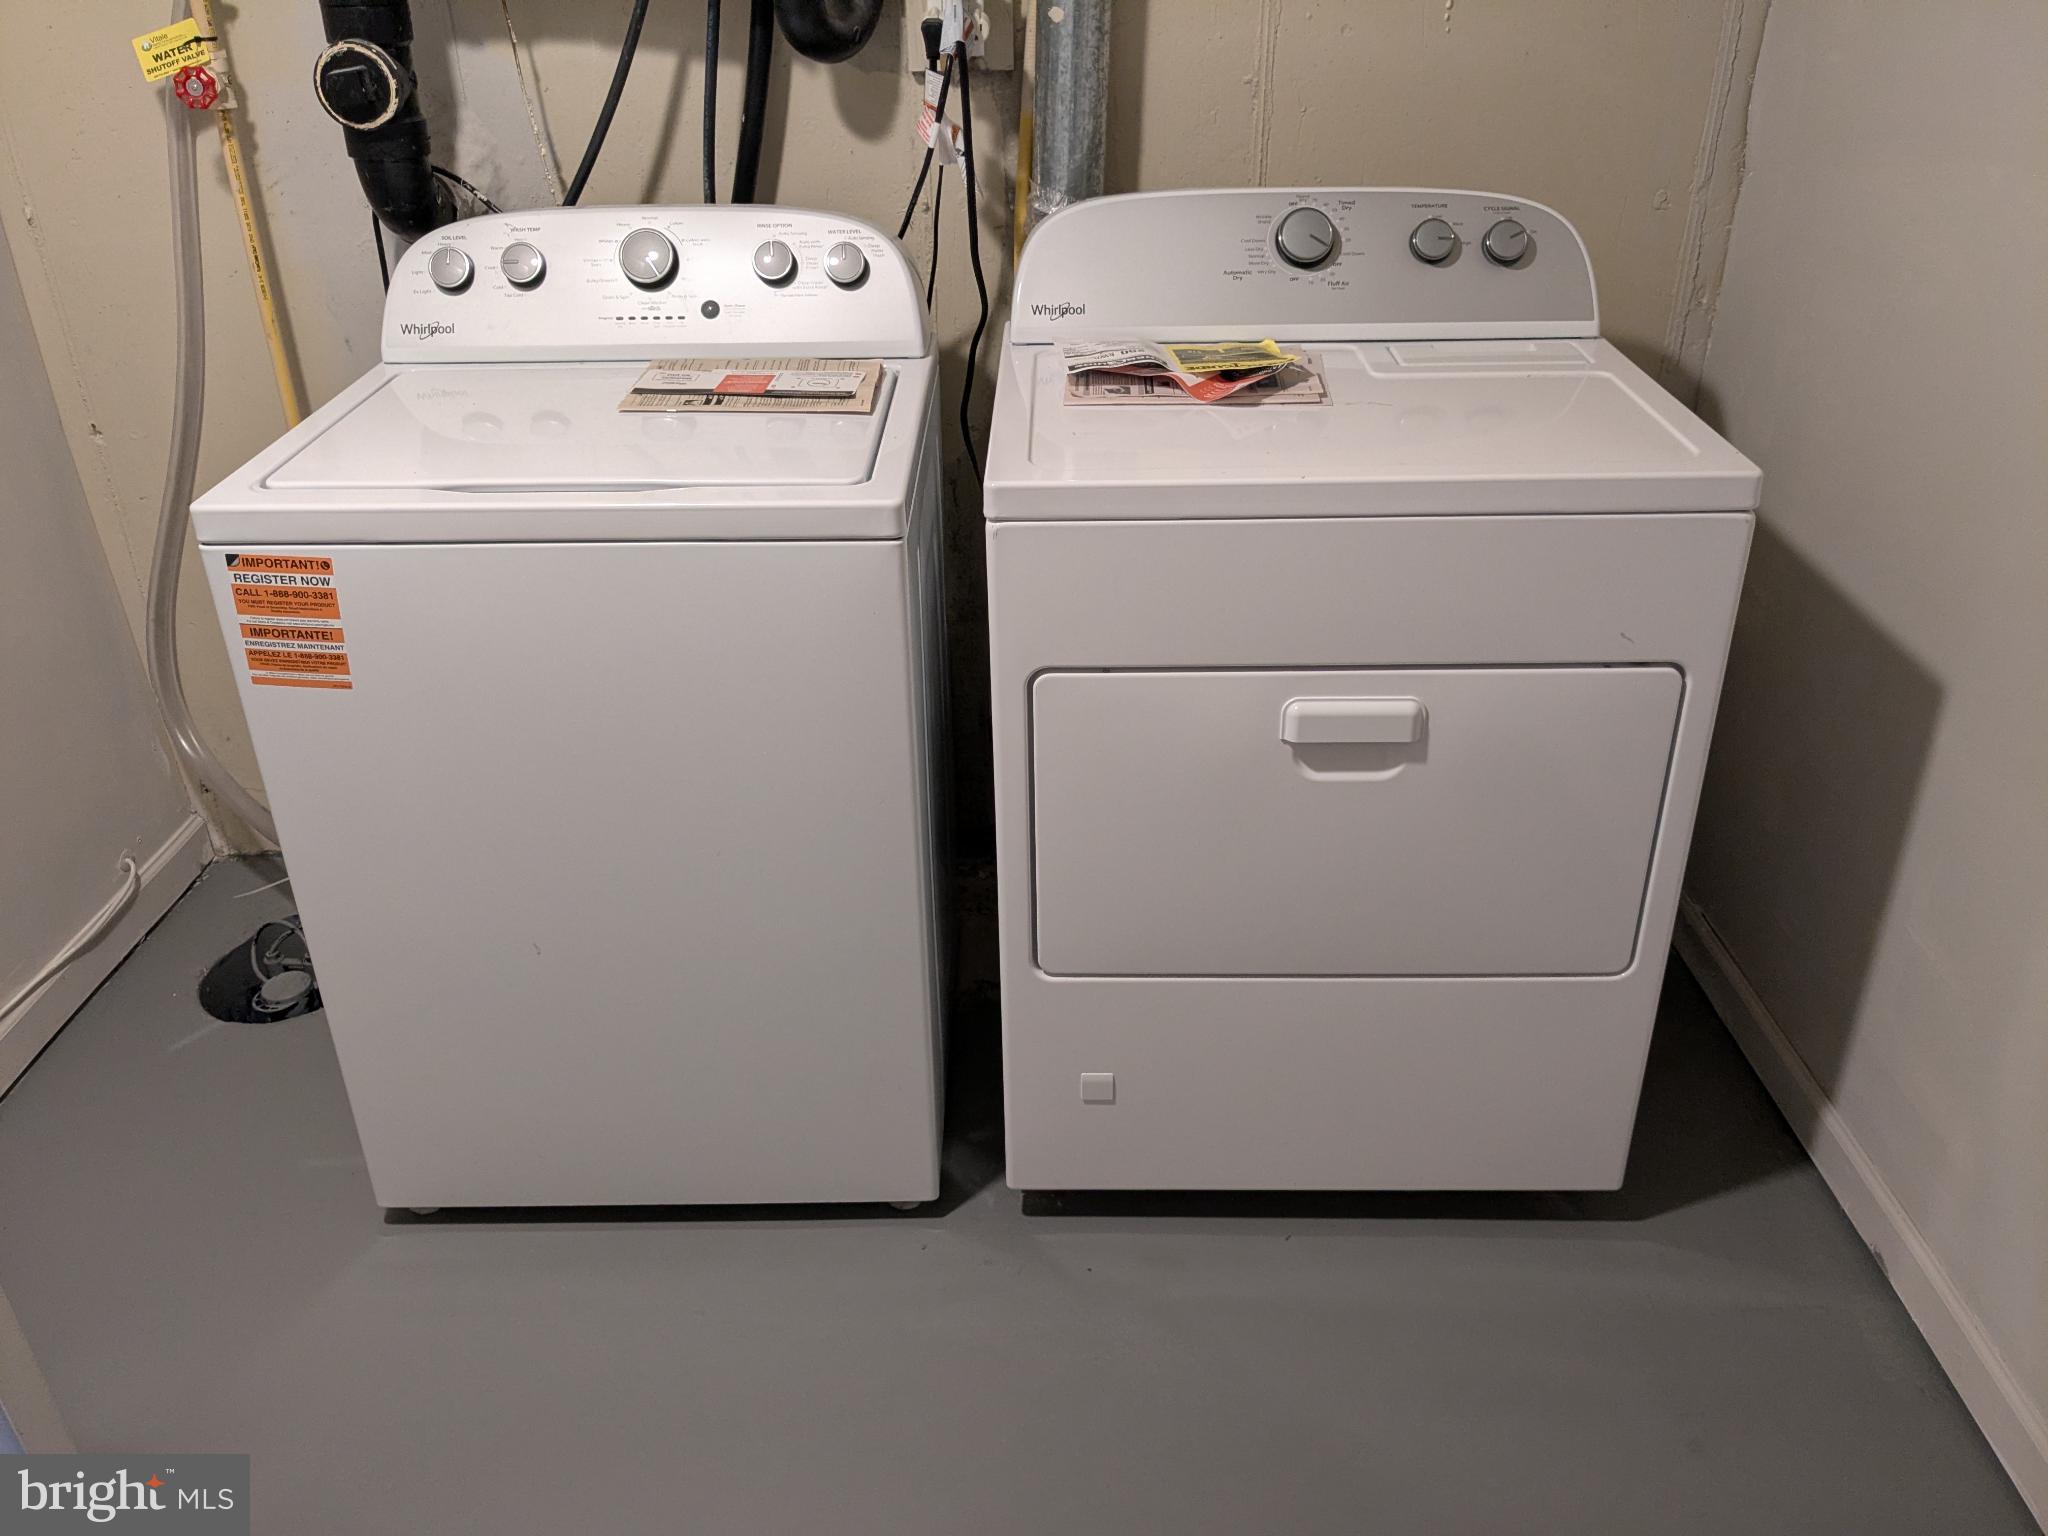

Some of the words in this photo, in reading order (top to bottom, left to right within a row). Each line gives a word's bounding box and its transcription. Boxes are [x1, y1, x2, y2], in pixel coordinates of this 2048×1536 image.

[152, 44, 192, 63] WATER
[146, 59, 180, 75] SHUTOFF
[182, 50, 206, 63] VALVE
[1031, 302, 1086, 321] Whirlpool
[400, 321, 455, 340] Whirlpool
[242, 557, 320, 570] IMPORTANT!
[233, 573, 297, 586] REGISTER
[301, 576, 330, 586] NOW
[235, 587, 262, 597] CALL
[264, 590, 334, 600] 1-888-900-3381
[250, 627, 333, 640] IMPORTANTE!
[245, 640, 295, 649] ENREGISTREZ
[297, 643, 344, 651] MAINTENANT
[248, 650, 281, 658] APPELEZ
